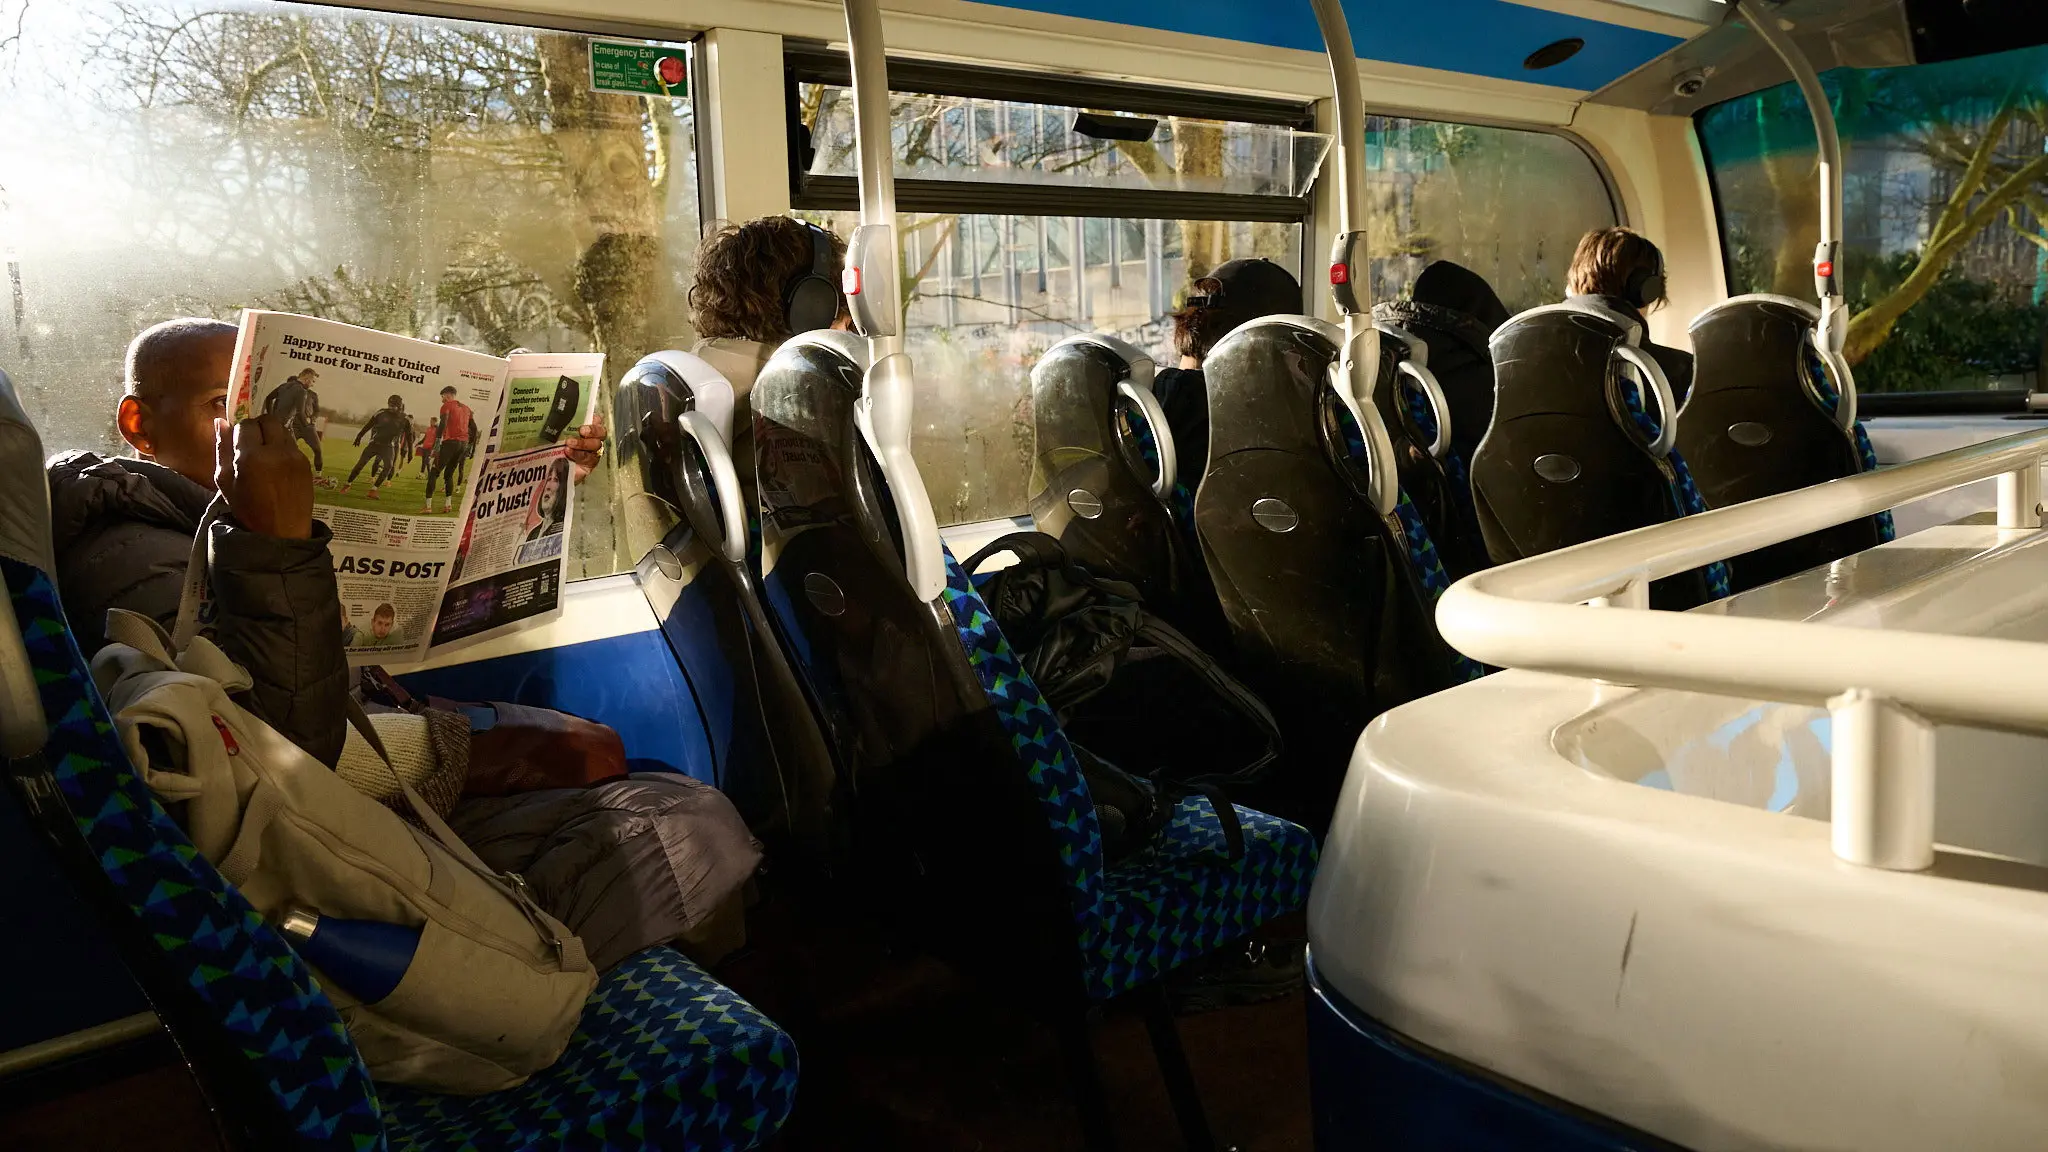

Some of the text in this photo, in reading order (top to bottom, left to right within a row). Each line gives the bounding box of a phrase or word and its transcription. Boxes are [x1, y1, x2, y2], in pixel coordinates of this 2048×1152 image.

[595, 44, 655, 59] Emergency Exit
[614, 62, 619, 70] of
[596, 71, 624, 80] emergency
[596, 78, 611, 86] break
[611, 79, 625, 88] glass
[282, 334, 326, 352] Happy
[326, 343, 379, 362] returns
[381, 354, 396, 365] at
[398, 357, 441, 375] United
[289, 348, 313, 362] but
[314, 354, 338, 367] not
[339, 358, 361, 372] for
[363, 363, 425, 384] Rashford
[512, 387, 534, 395] Connect
[510, 396, 530, 405] another
[509, 405, 535, 414] every time
[507, 413, 545, 425] you lose signal
[506, 464, 547, 488] boom
[477, 500, 495, 519] or
[495, 486, 533, 515] bust!
[388, 560, 446, 579] POST
